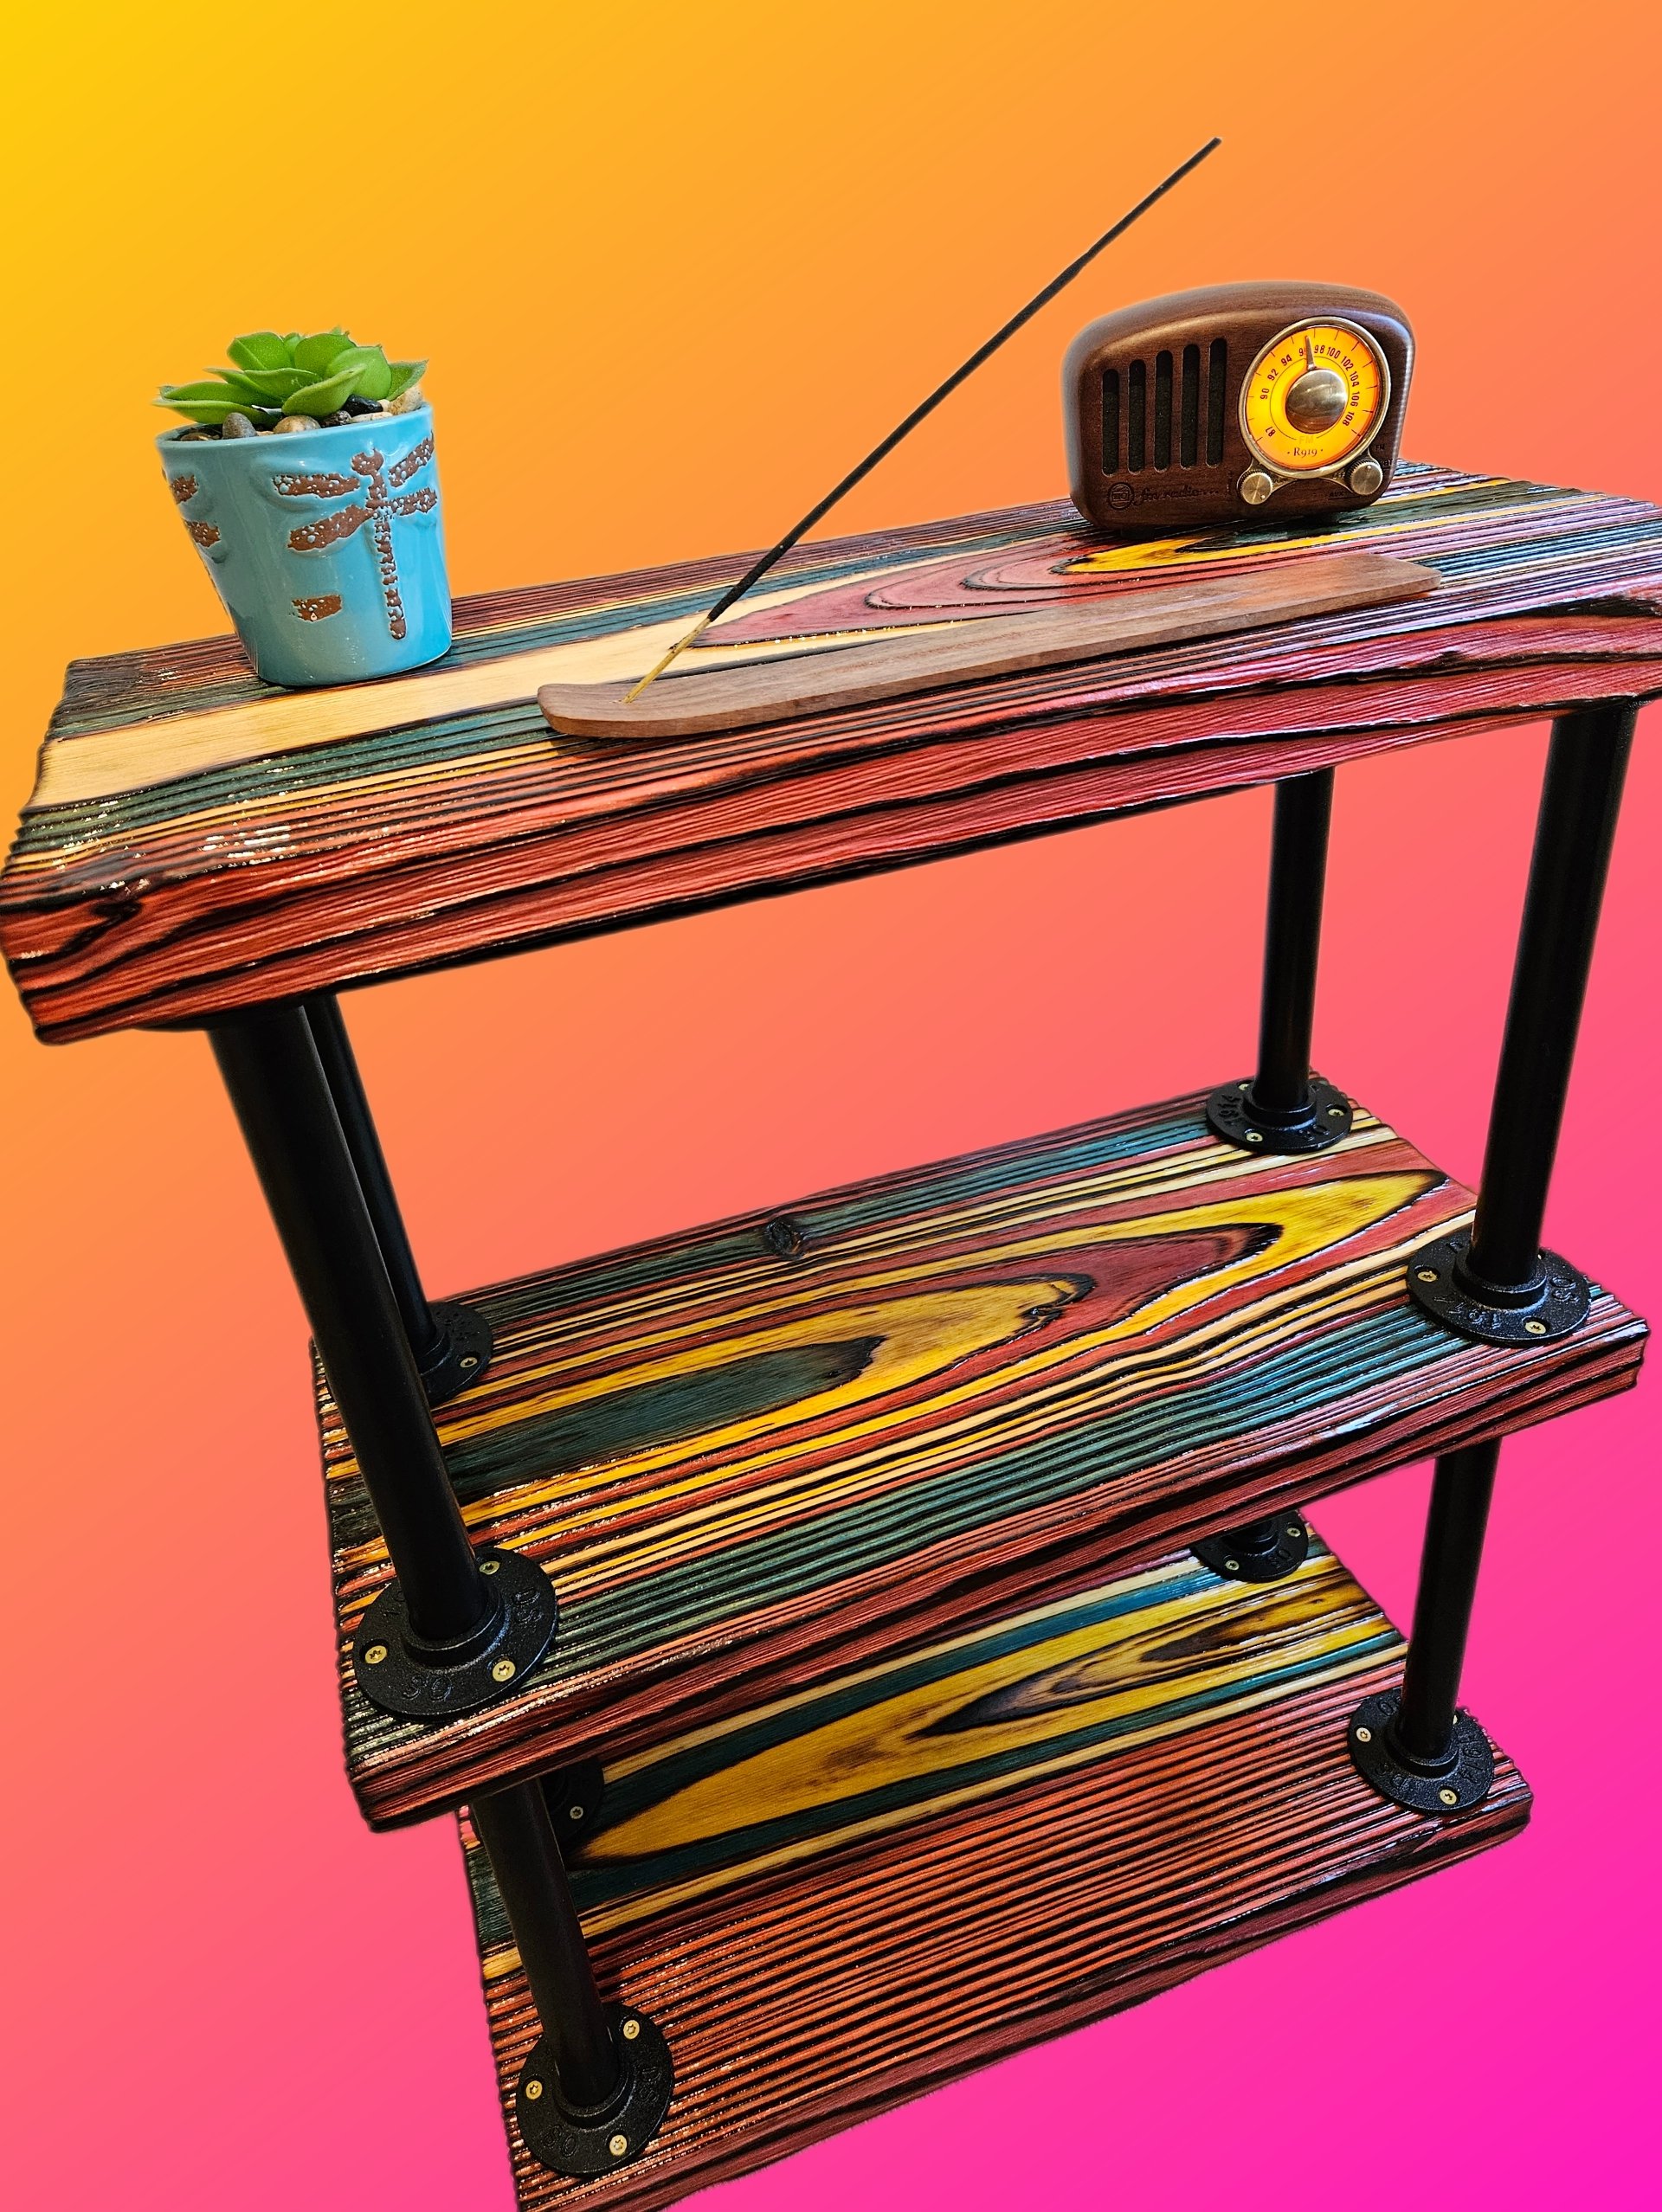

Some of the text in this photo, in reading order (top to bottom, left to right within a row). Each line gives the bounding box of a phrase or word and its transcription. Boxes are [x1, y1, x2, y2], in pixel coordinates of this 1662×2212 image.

[1314, 344, 1325, 354] 98
[1327, 346, 1341, 359] 100
[1280, 354, 1292, 366] 94
[1340, 356, 1354, 372] 102
[1266, 368, 1279, 381] 92
[1349, 370, 1360, 387] 104
[1259, 388, 1270, 400] 90
[1350, 391, 1360, 407] 106
[1342, 411, 1356, 427] 108
